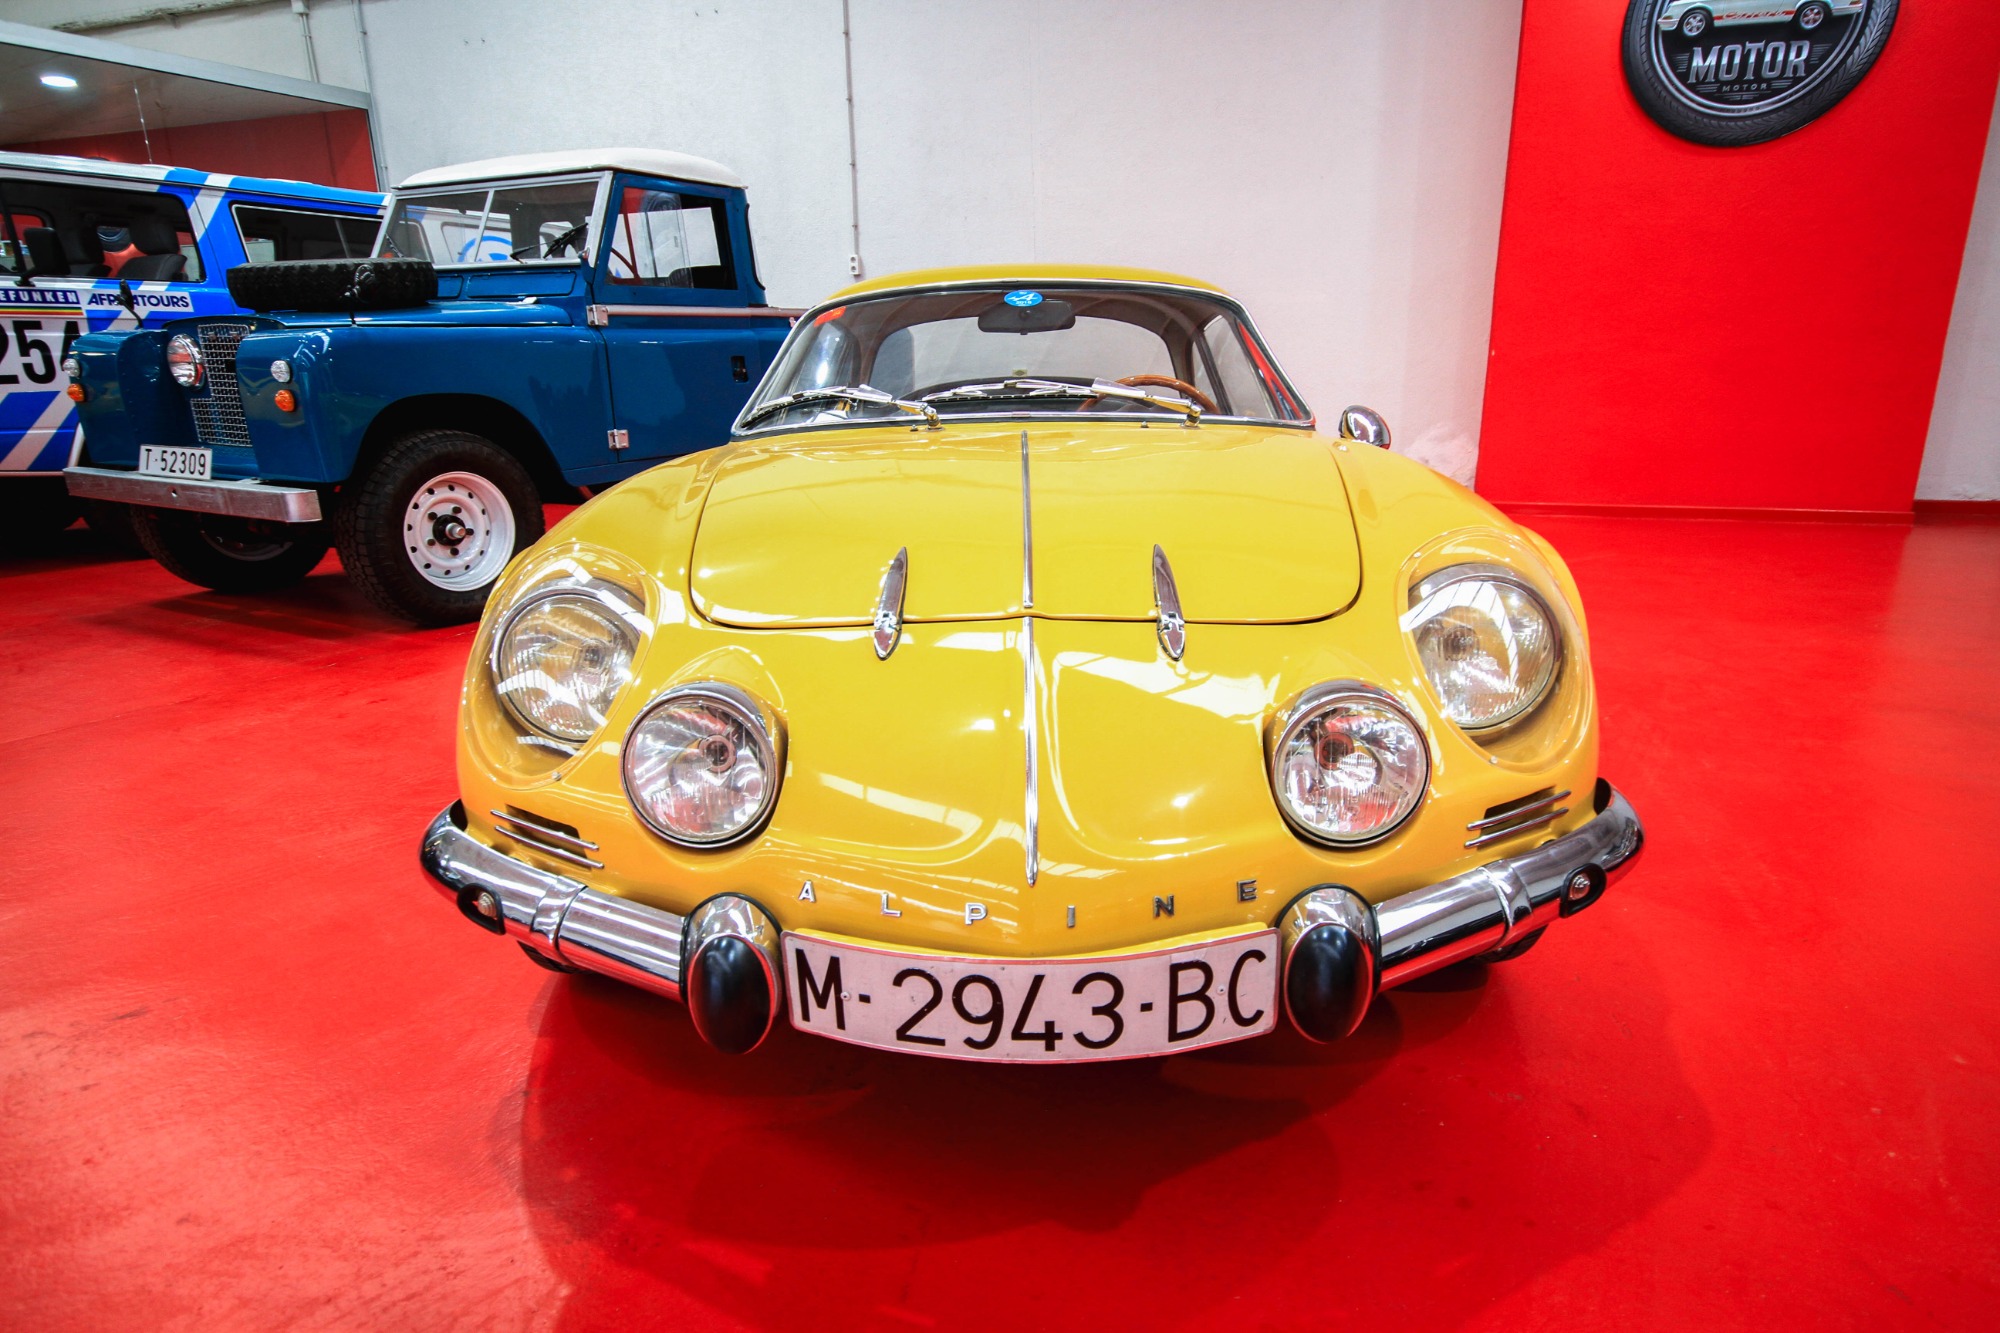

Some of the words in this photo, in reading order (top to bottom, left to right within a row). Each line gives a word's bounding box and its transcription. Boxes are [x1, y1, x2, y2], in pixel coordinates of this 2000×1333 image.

[1687, 40, 1810, 84] MOTOR
[1722, 83, 1767, 92] MOTOR
[87, 293, 189, 308] AFRATOURS
[798, 879, 1258, 929] ALPINE
